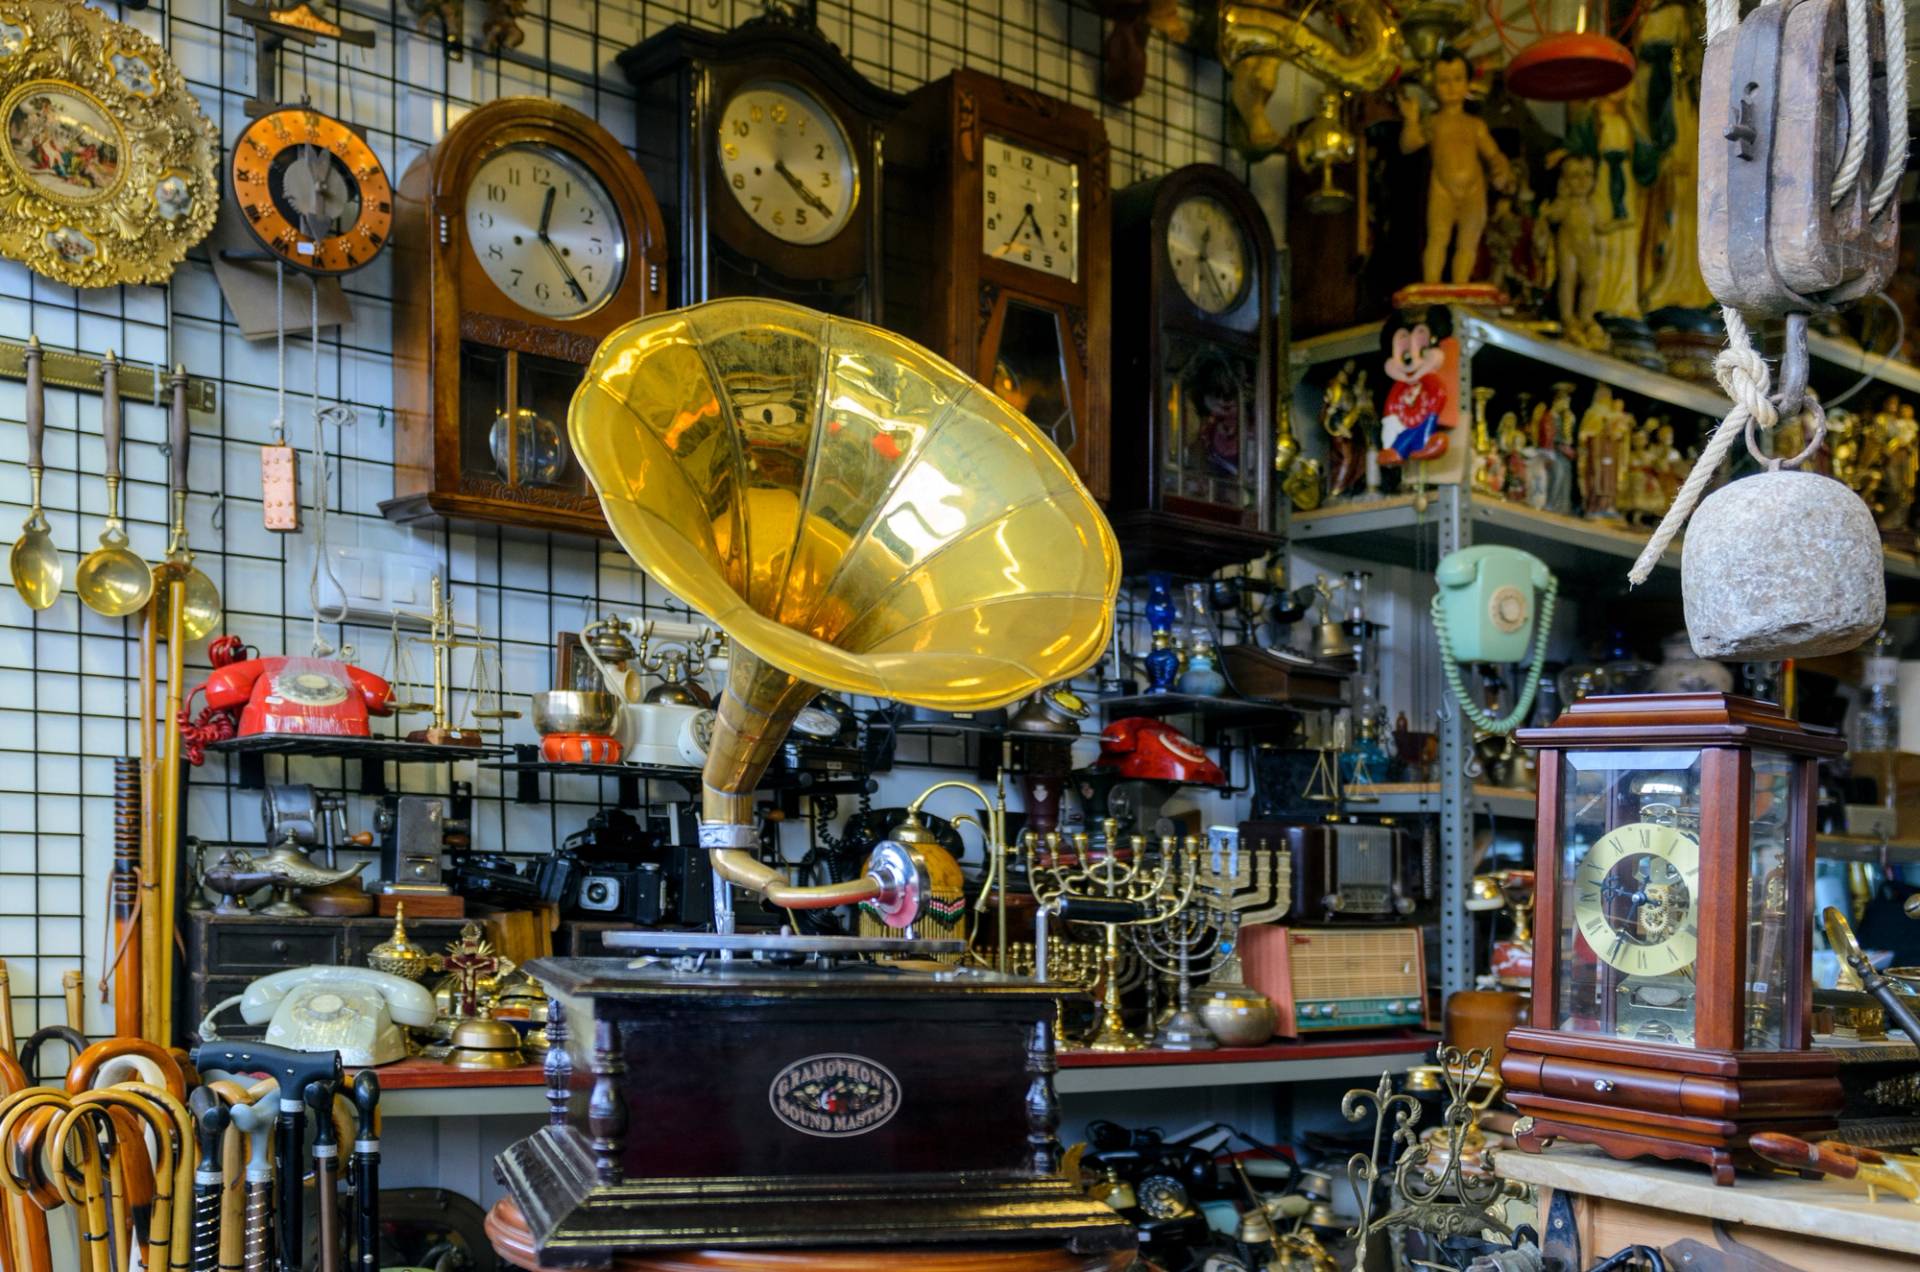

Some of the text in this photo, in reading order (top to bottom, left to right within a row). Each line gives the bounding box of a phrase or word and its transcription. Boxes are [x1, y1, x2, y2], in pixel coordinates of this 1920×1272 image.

[815, 144, 824, 160] 2
[1021, 156, 1033, 171] 12
[508, 167, 520, 186] 11
[533, 166, 550, 186] 12
[732, 173, 745, 189] 8
[821, 172, 831, 188] 3
[488, 184, 506, 202] 10
[565, 181, 571, 199] 1
[987, 190, 996, 204] 9
[1059, 188, 1068, 201] 2
[752, 195, 762, 213] 7
[479, 211, 493, 229] 9
[580, 207, 594, 225] 2
[772, 210, 784, 225] 6
[796, 208, 807, 225] 5
[987, 217, 996, 231] 8
[1059, 214, 1068, 228] 3
[488, 244, 503, 262] 8
[510, 268, 524, 287] 7
[535, 283, 550, 301] 6
[777, 1060, 893, 1097] GRAMOPHONE
[778, 1094, 893, 1131] SOUND MASTER
